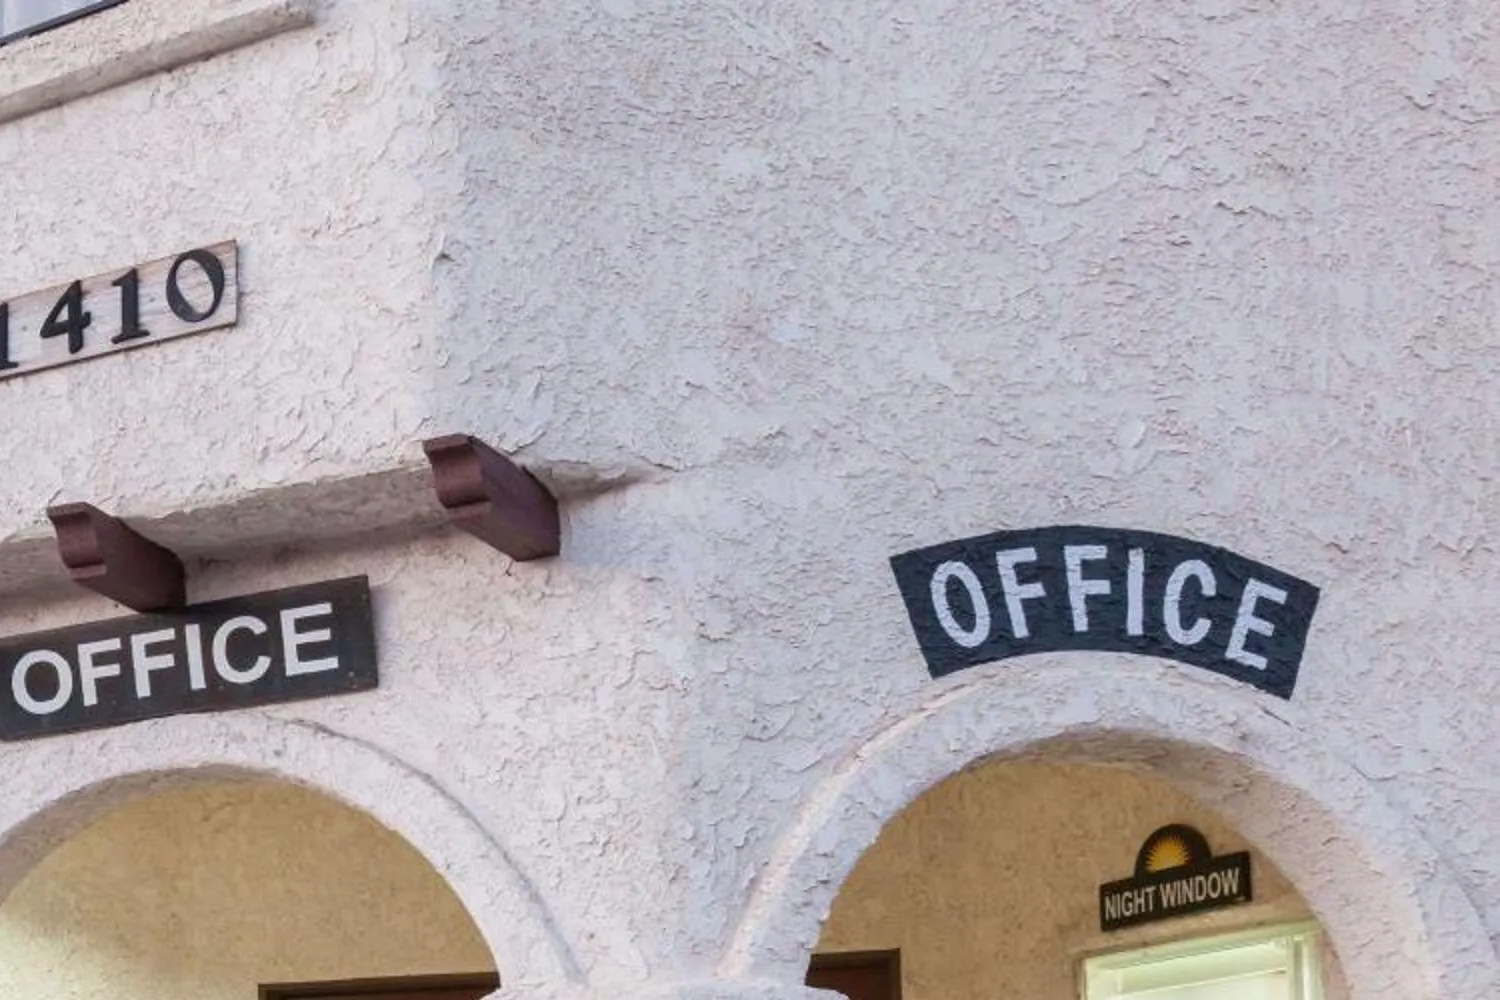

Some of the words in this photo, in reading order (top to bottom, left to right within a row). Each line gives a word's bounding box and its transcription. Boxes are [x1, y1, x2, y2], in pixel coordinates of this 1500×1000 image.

[11, 602, 339, 715] OFFICE
[930, 544, 1288, 671] OFFICE
[1105, 886, 1156, 920] NIGHT
[1160, 867, 1240, 909] WINDOW
